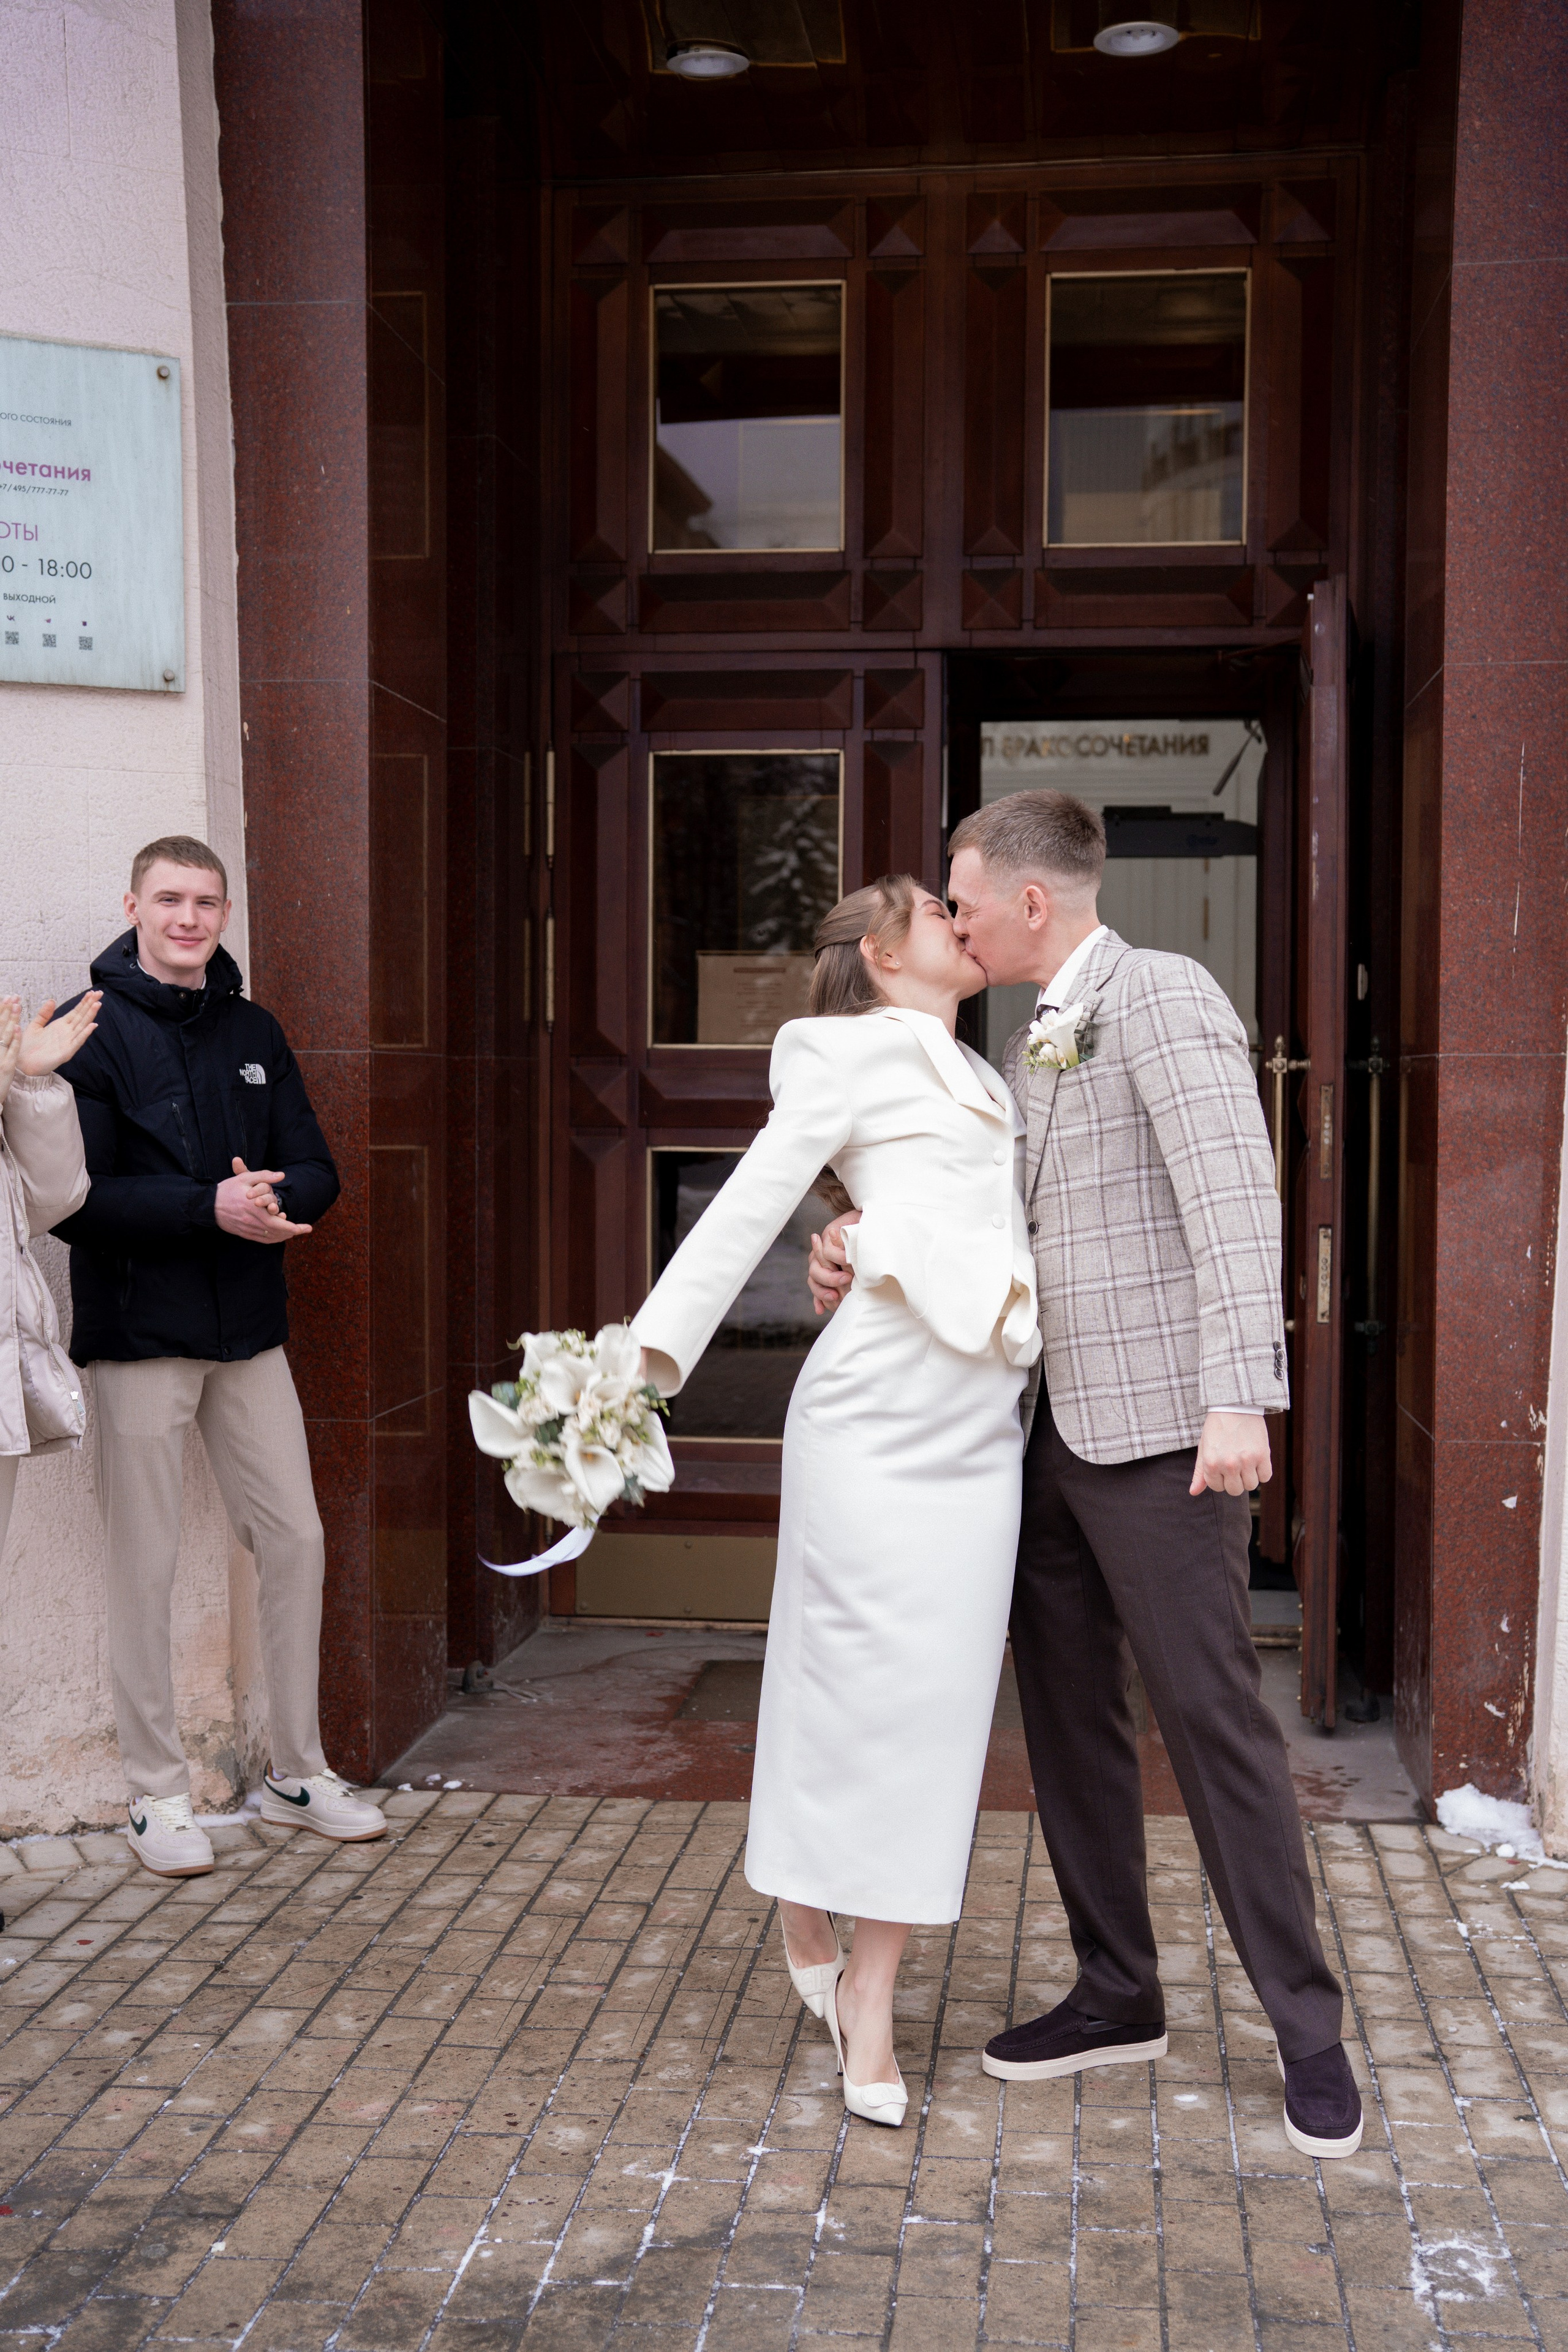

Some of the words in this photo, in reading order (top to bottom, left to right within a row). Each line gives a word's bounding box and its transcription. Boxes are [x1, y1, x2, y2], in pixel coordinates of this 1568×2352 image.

[20, 415, 72, 426] состояния
[0, 460, 91, 481] четания
[38, 558, 92, 579] 18:00
[4, 593, 56, 604] выходной
[239, 1069, 257, 1077] NORTH
